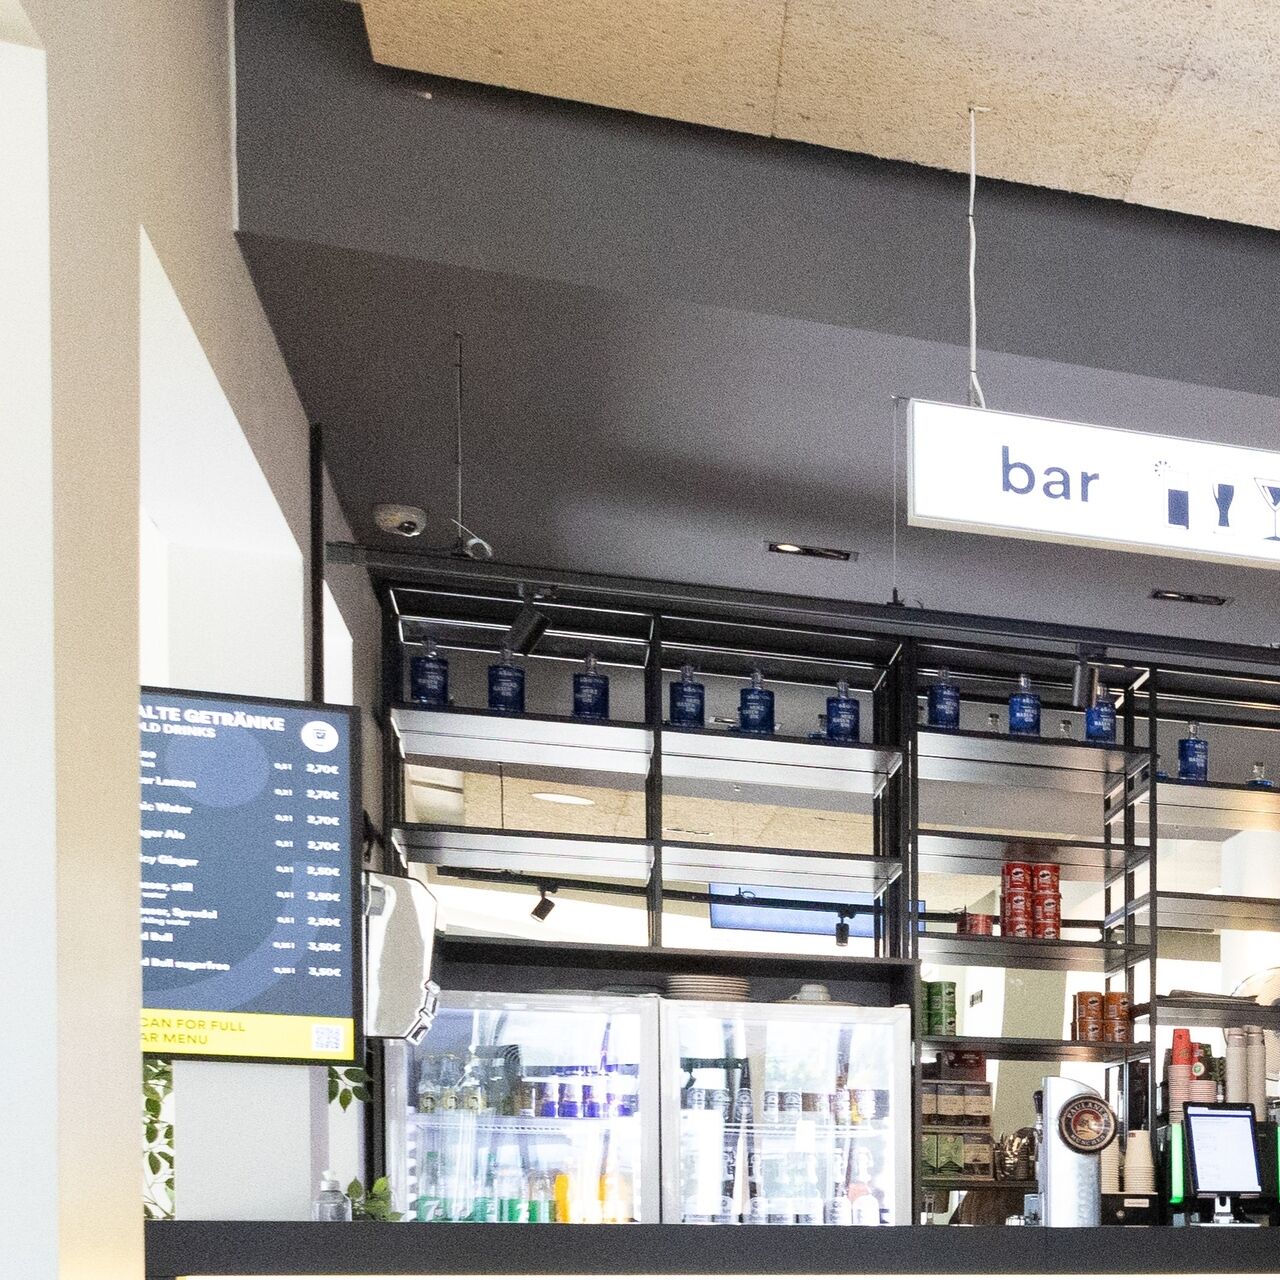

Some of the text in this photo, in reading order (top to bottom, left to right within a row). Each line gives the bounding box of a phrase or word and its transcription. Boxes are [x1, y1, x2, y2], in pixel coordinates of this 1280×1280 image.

[1001, 445, 1100, 502] bar
[139, 704, 286, 731] ALTE GETRÄNKE
[163, 723, 217, 738] DRINKS
[141, 1017, 245, 1032] CAN FOR FULL
[141, 1033, 208, 1045] AR MENU
